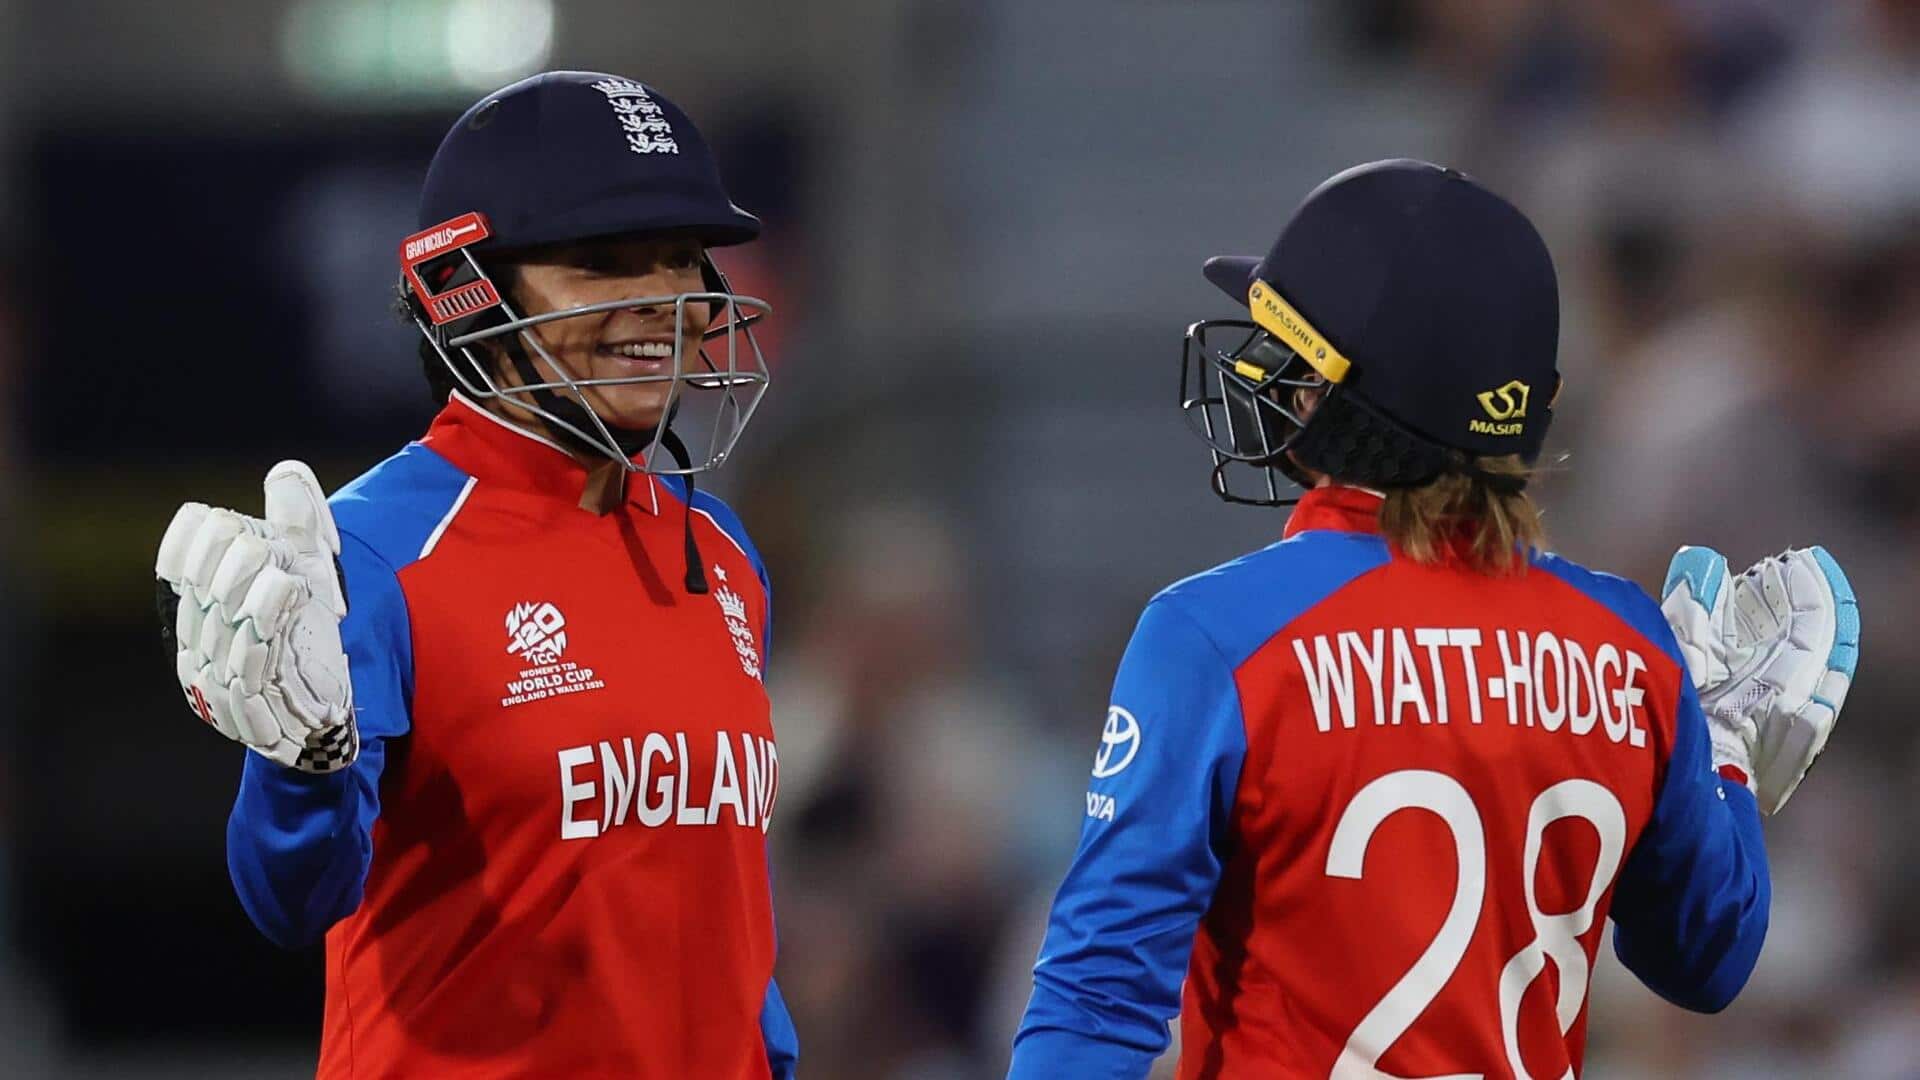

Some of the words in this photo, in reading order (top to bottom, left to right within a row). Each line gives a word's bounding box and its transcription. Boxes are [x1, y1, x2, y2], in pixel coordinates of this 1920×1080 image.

[1265, 299, 1313, 348] MASURI
[520, 665, 561, 678] WOMEN'S
[561, 662, 577, 671] T20
[533, 652, 557, 666] ICC
[502, 690, 547, 707] ENGLAND
[556, 682, 585, 695] WALES
[507, 674, 563, 695] WORLD
[565, 668, 593, 684] CUP
[1292, 628, 1648, 748] WYATT-HODGE
[558, 731, 779, 840] ENGLAND
[1325, 769, 1626, 1080] 28
